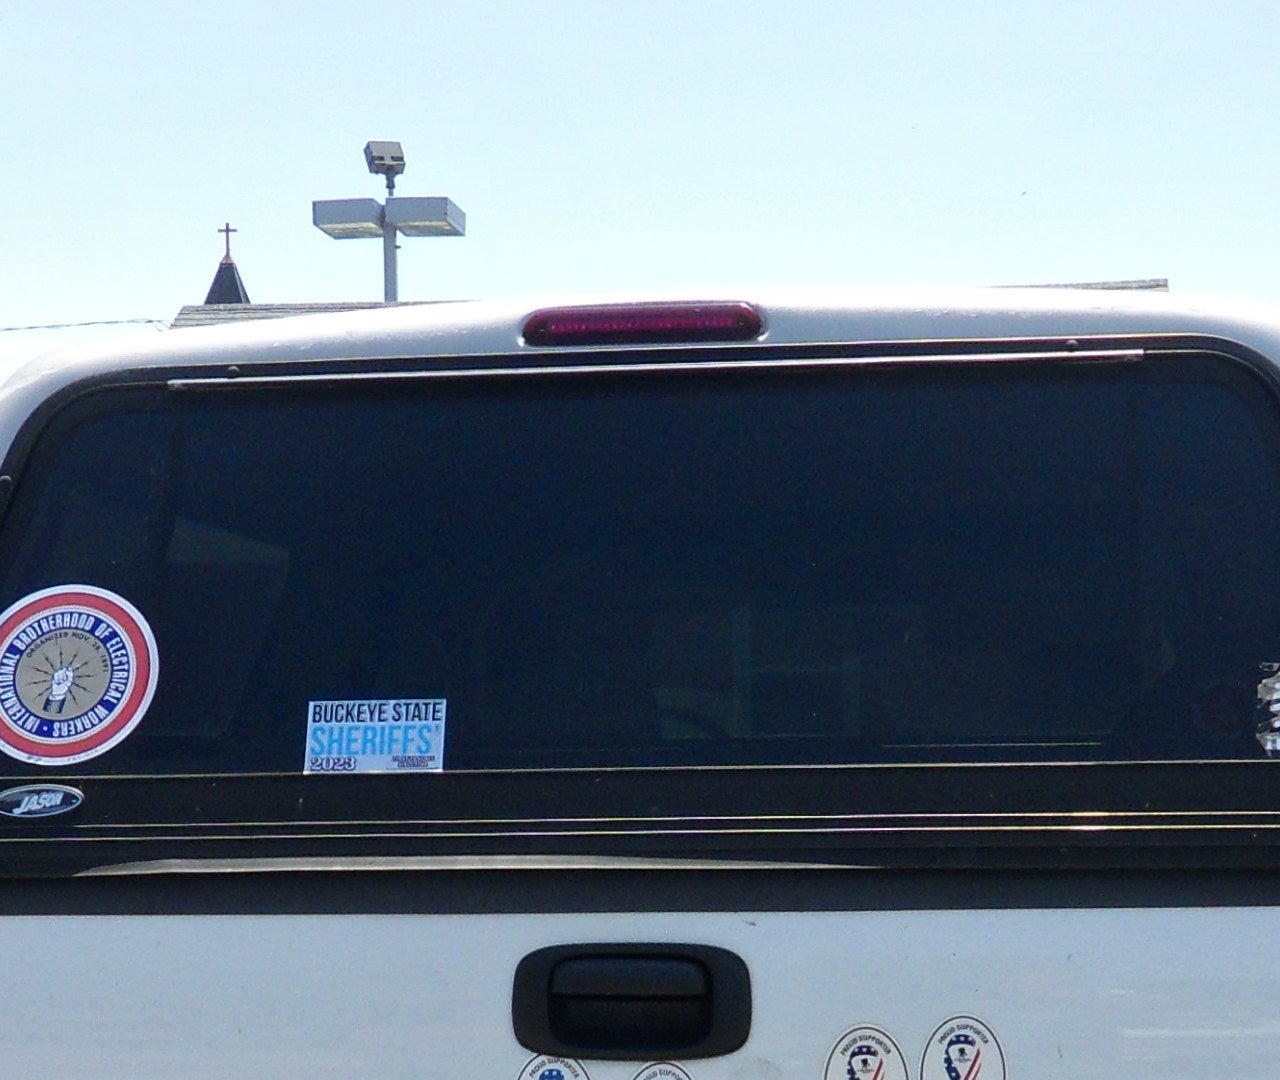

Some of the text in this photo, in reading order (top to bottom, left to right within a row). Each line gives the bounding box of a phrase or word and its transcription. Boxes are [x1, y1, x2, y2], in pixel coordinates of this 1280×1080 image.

[13, 613, 95, 651] BROTHERHOOD
[95, 622, 113, 639] OF
[26, 632, 69, 658] ORGANIZED
[106, 637, 129, 704] ELECTRICAL
[53, 705, 109, 737] WORKERS
[312, 702, 442, 723] BUCKEYE STATE
[310, 725, 440, 755] SHERIFFS'
[310, 756, 357, 771] 2023
[12, 792, 64, 815] JASON
